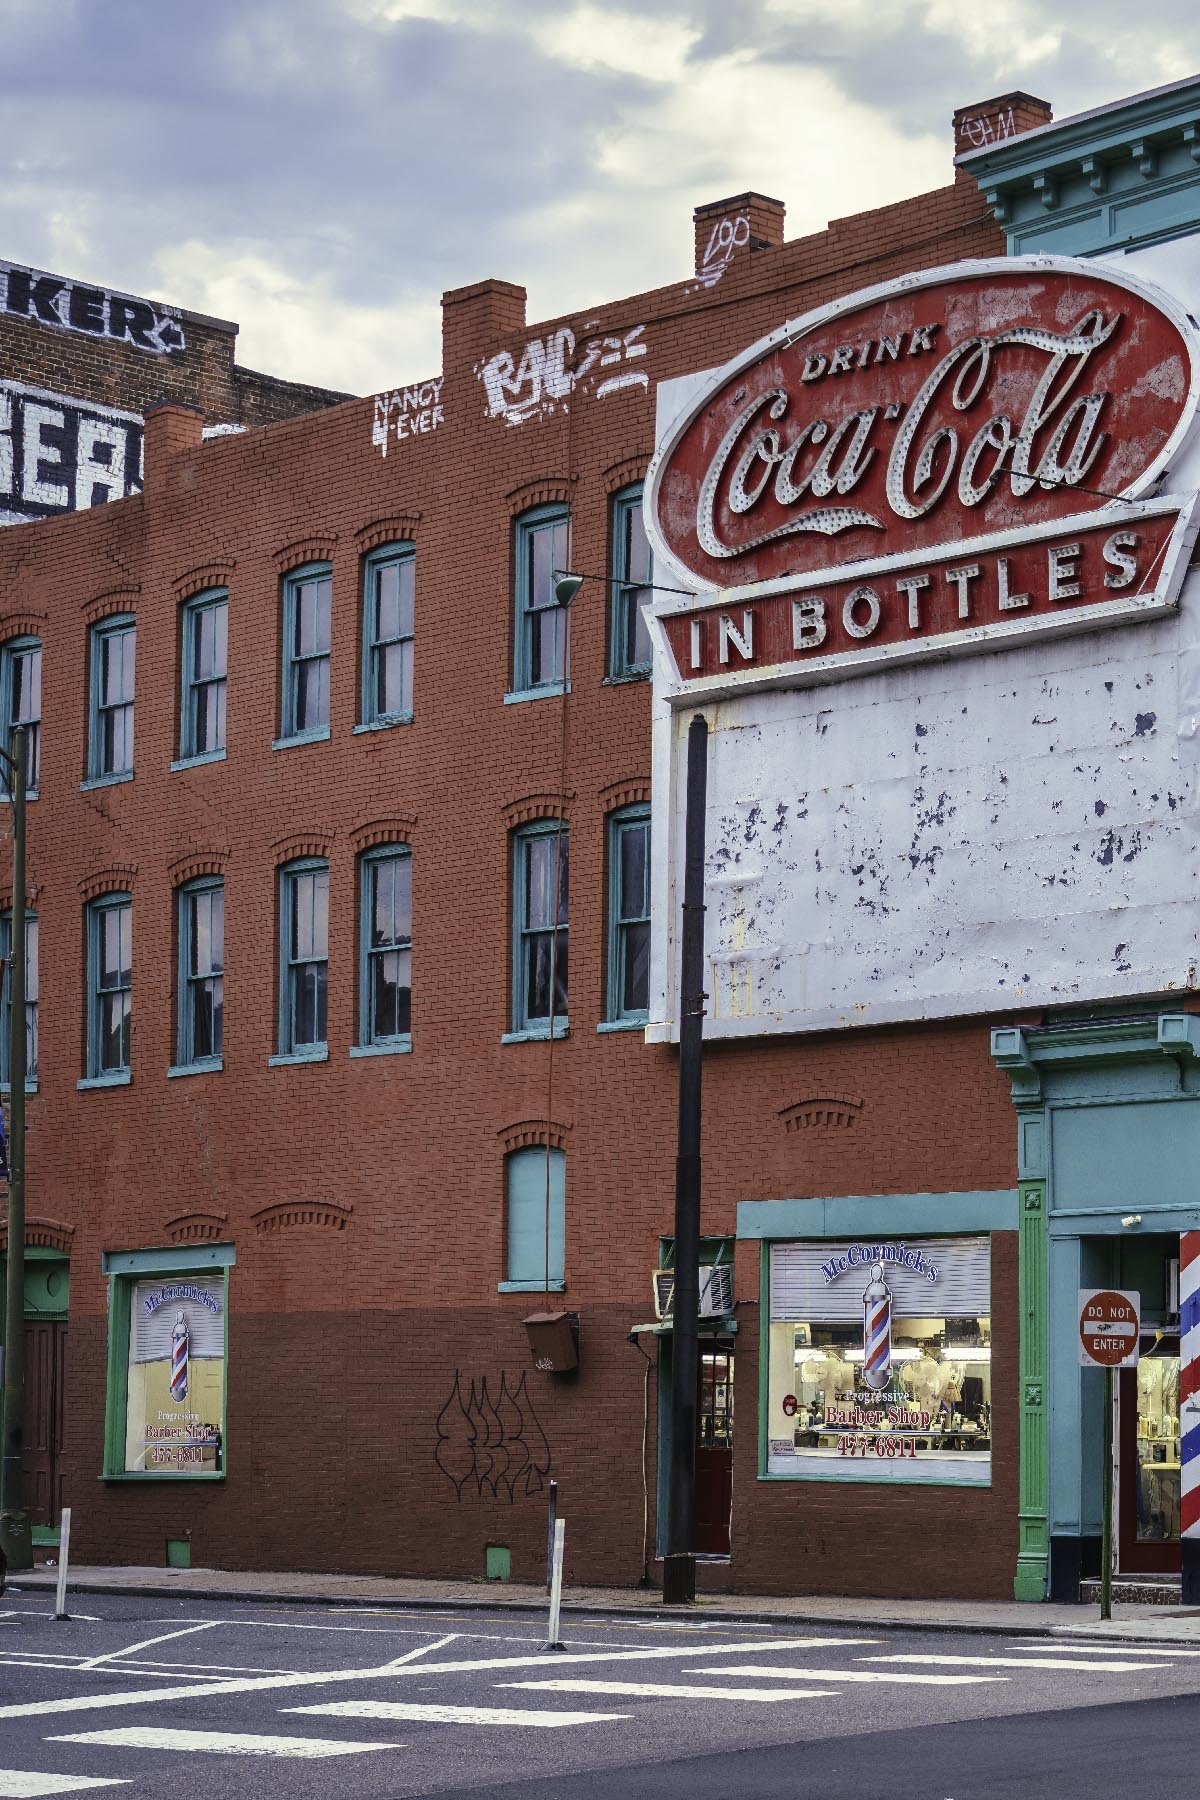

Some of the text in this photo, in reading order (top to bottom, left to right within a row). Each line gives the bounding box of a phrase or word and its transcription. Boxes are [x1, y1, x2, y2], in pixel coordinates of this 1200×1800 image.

[801, 323, 940, 383] DRINK
[374, 376, 444, 420] NANCY
[697, 309, 1123, 558] Coca-Cola
[690, 531, 1139, 669] IN BOTTLES
[819, 1242, 939, 1285] McCormick's
[1088, 1306, 1131, 1319] DO NOT
[1093, 1338, 1125, 1350] ENTER
[845, 1389, 910, 1404] Progressive
[158, 1410, 199, 1421] Progressive
[825, 1405, 932, 1427] Barber Shop
[145, 1424, 212, 1440] Barber Shop
[152, 1447, 204, 1463] 477-6811
[838, 1435, 917, 1458] 477-6811
